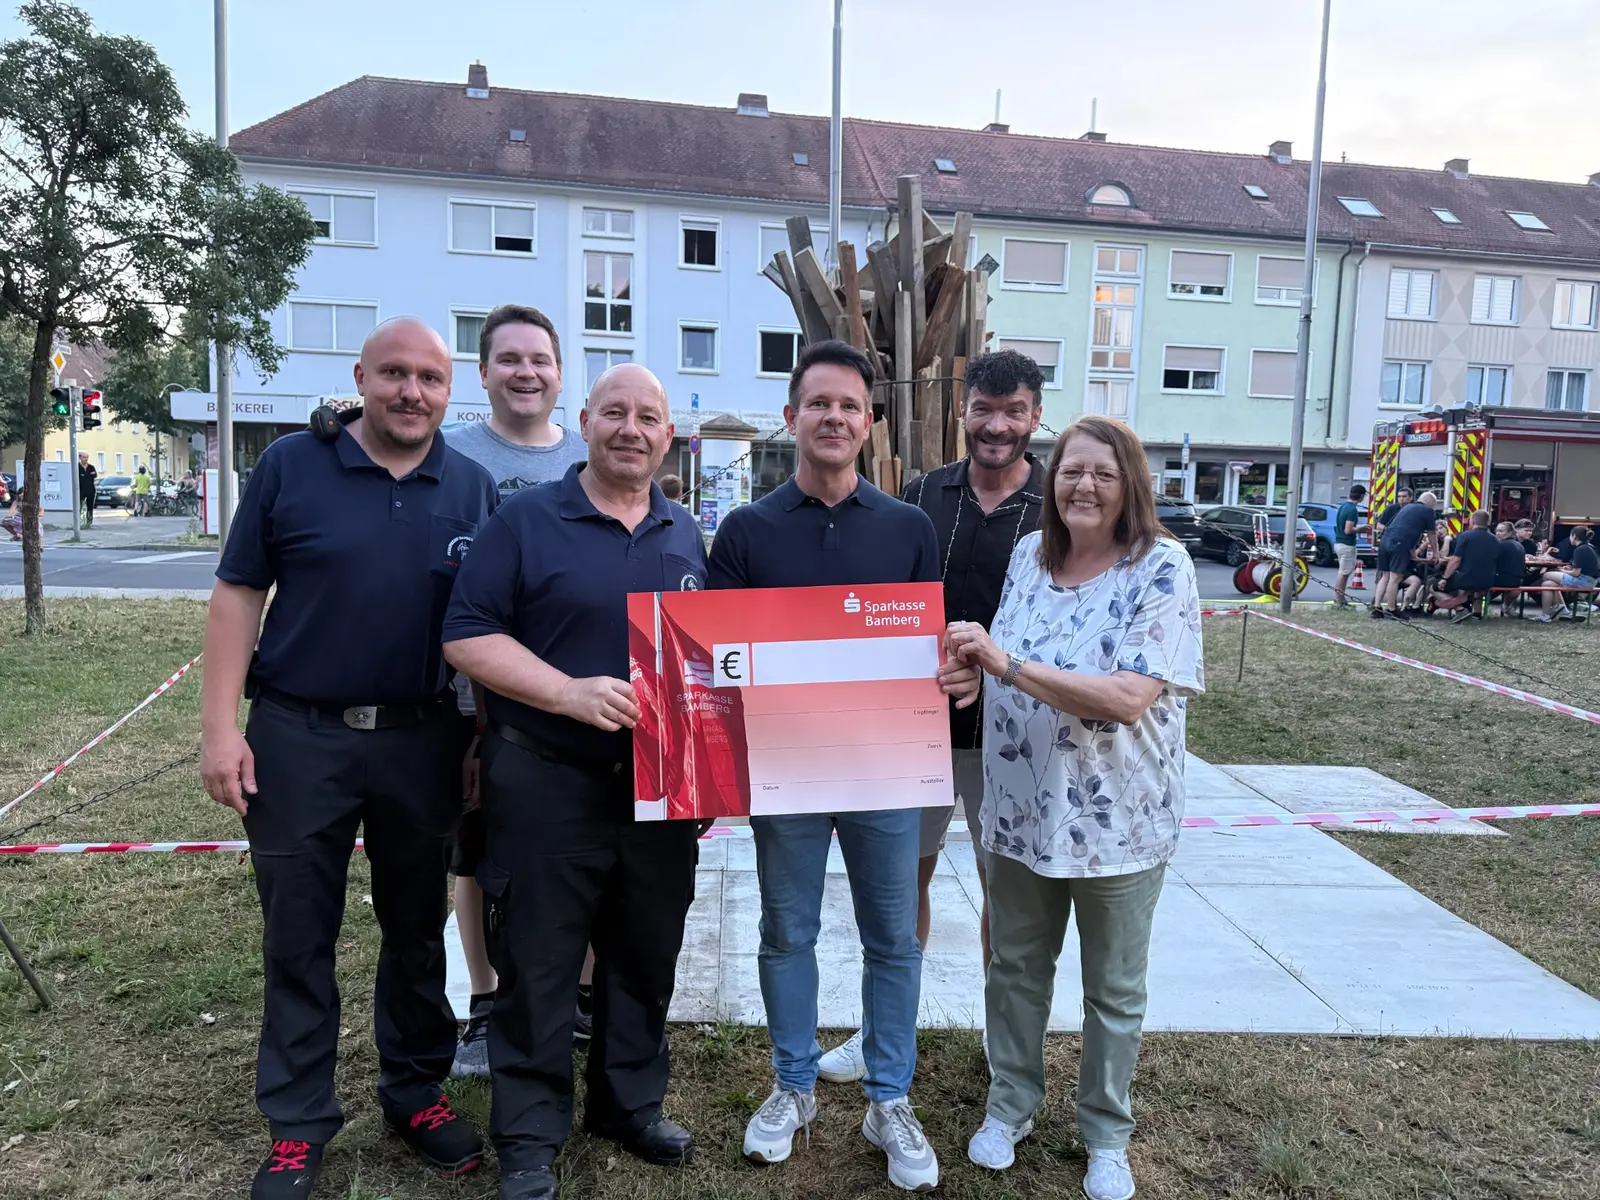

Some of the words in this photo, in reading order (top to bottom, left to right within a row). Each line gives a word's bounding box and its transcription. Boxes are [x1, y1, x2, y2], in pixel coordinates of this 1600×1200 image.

[207, 402, 273, 414] BKEREI
[864, 600, 926, 614] Sparkasse
[865, 614, 921, 628] Bamberg
[720, 650, 742, 680] €
[676, 691, 734, 705] SPARKASSE
[681, 702, 731, 714] BAMBERG
